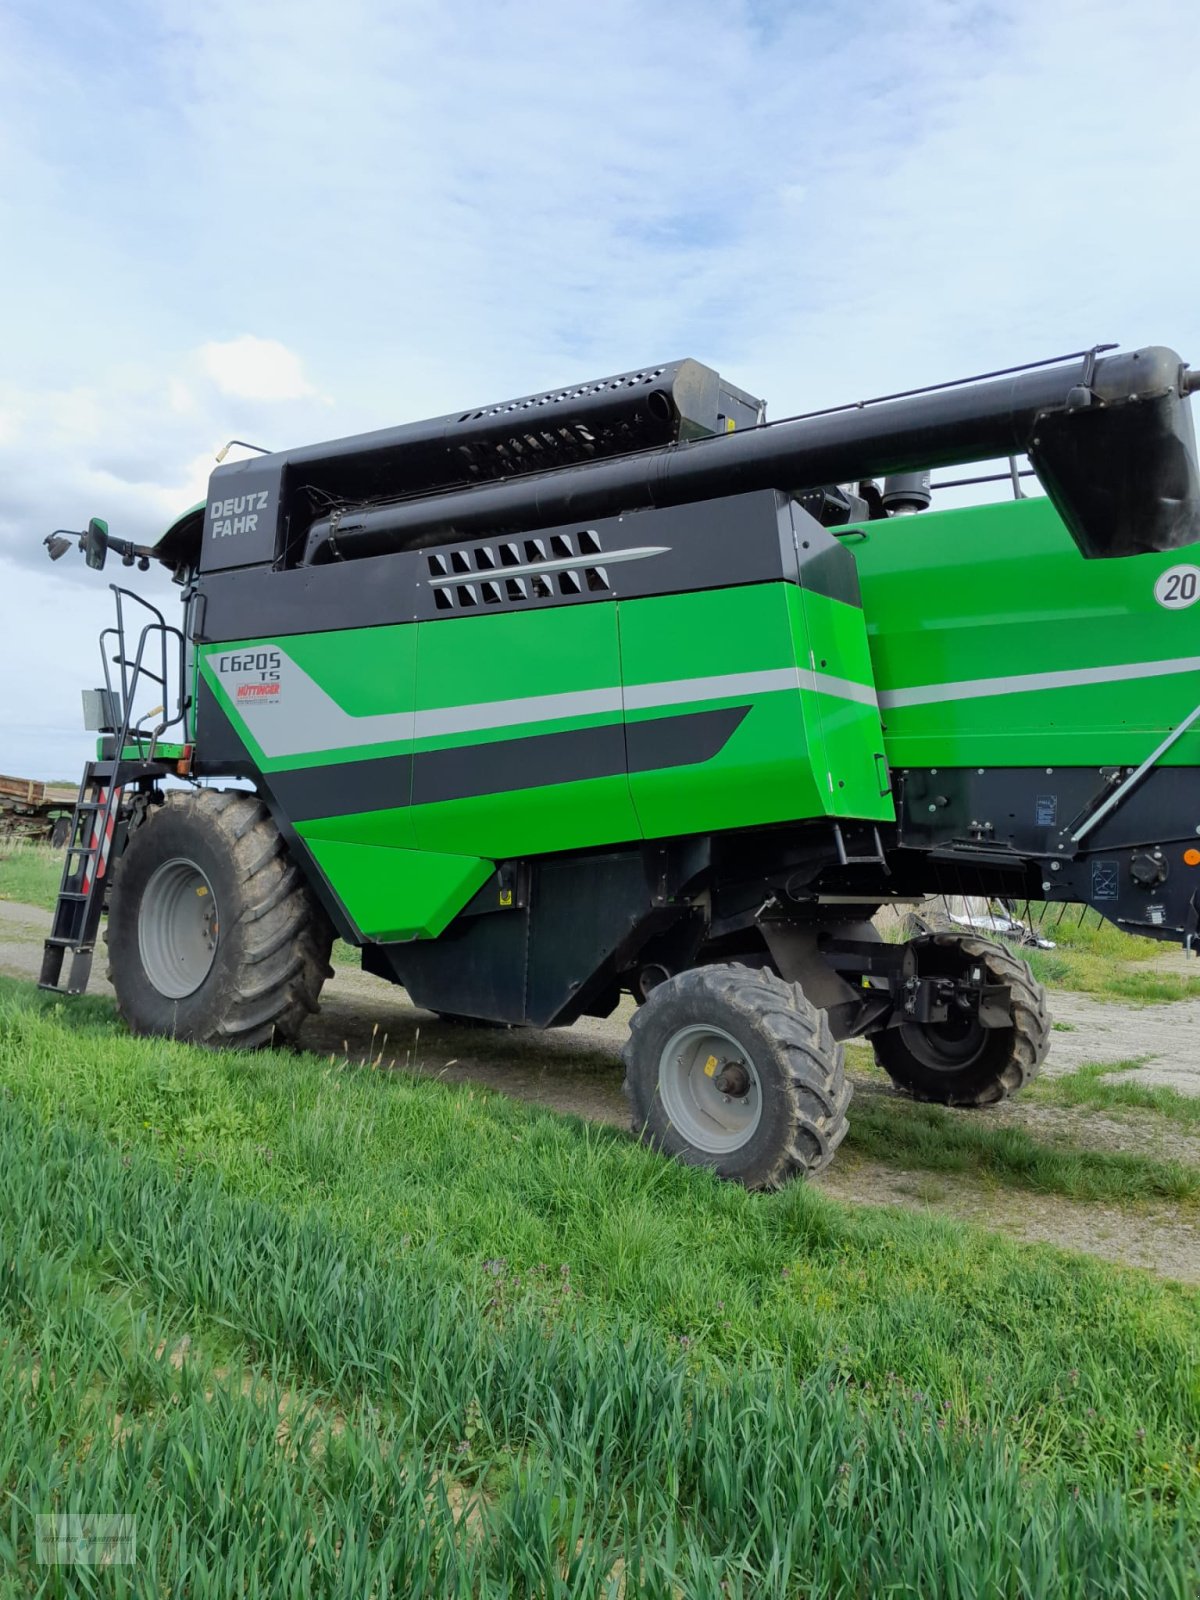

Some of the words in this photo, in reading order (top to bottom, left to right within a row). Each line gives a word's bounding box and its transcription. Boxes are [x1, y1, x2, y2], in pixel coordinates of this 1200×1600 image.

[210, 490, 269, 520] DEUTZ
[212, 514, 258, 539] FAHR
[1163, 573, 1197, 601] 20
[219, 652, 281, 673] C6205
[259, 670, 281, 681] TS
